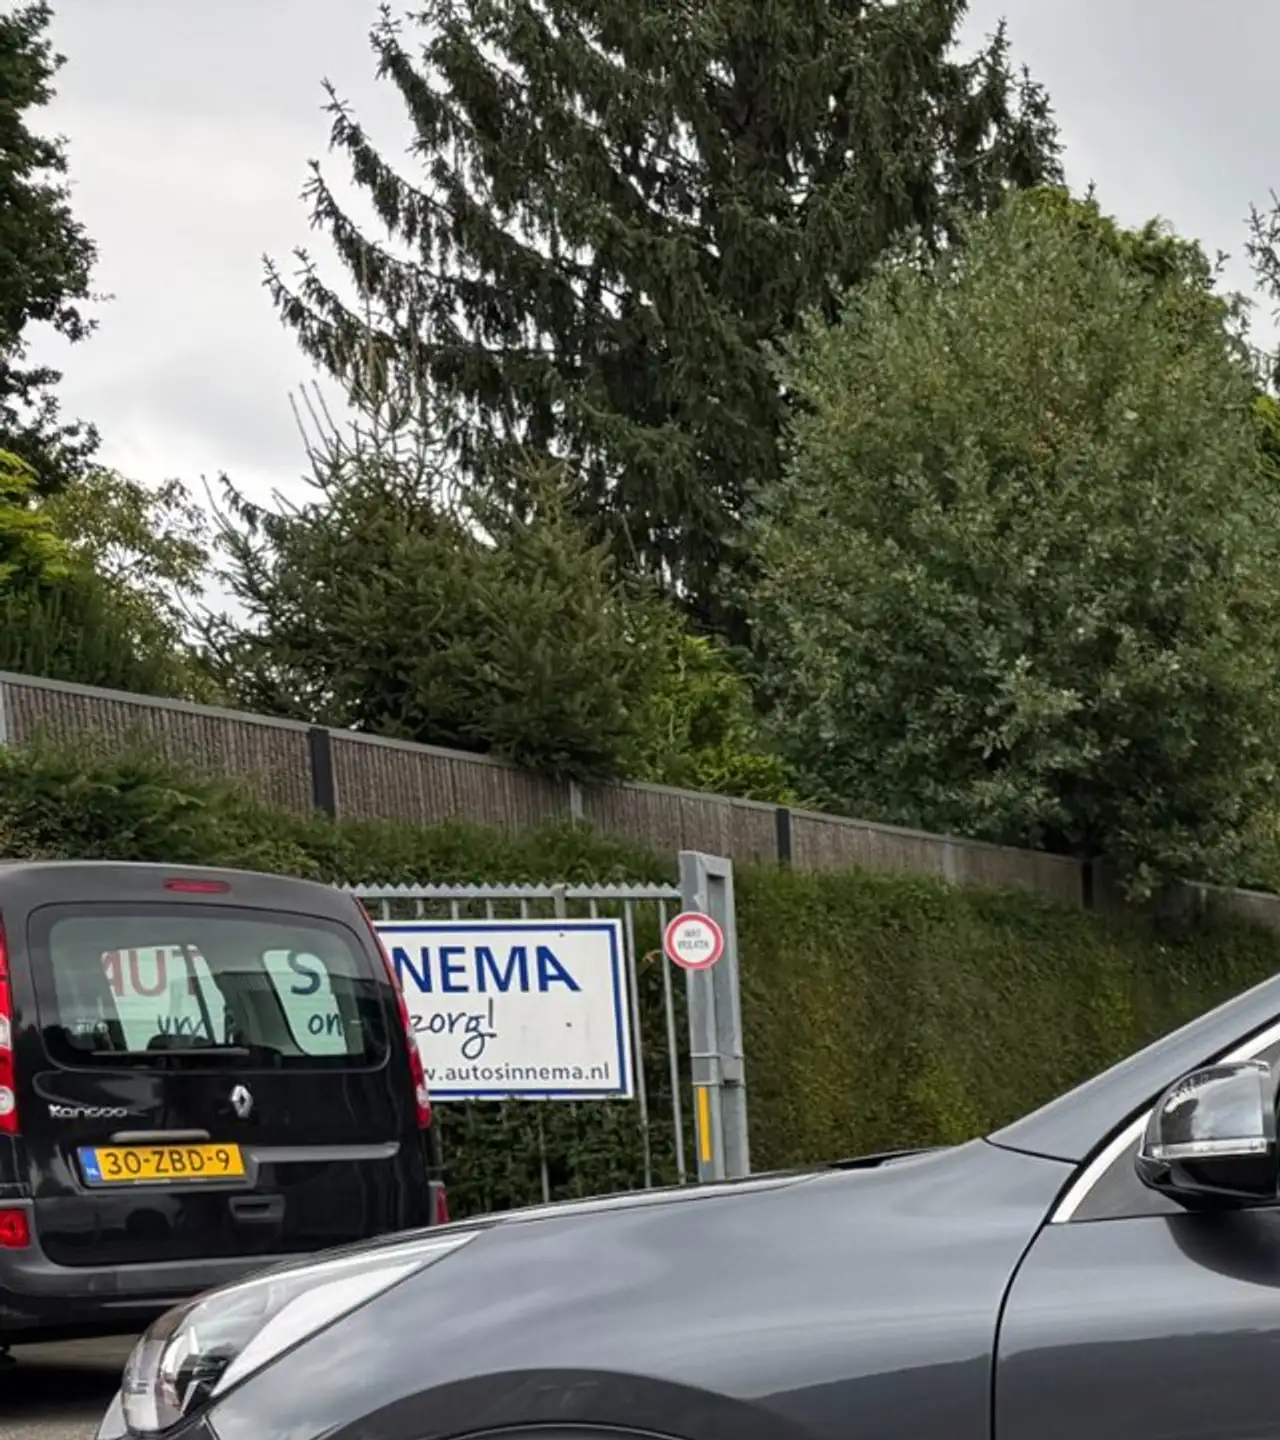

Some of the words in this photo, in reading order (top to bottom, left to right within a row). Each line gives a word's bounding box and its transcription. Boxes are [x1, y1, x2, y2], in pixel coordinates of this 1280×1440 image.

[409, 998, 497, 1060] zorg!
[423, 1062, 610, 1082] w.autosinnema.nl
[104, 1149, 230, 1175] 30-ZBD-9
